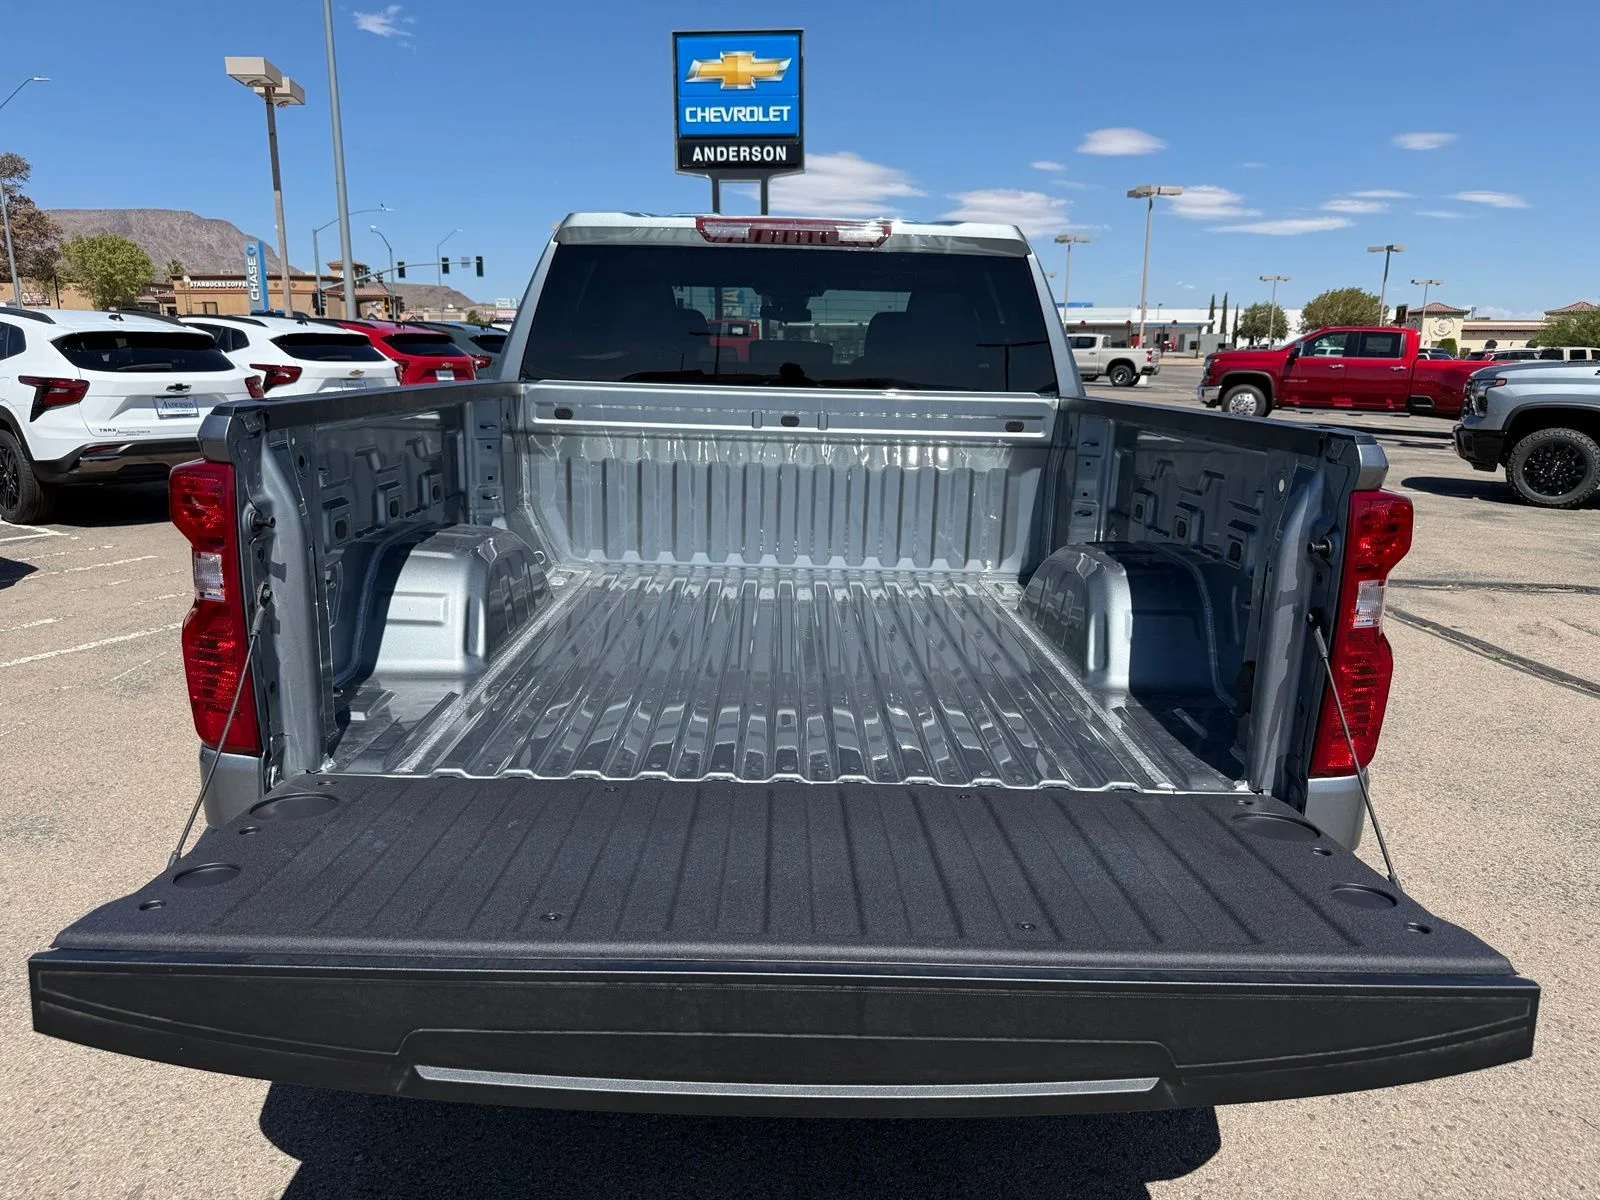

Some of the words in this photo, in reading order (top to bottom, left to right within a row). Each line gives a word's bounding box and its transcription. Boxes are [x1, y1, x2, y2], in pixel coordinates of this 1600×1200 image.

[685, 105, 792, 123] CHEVROLET
[692, 146, 787, 162] ANDERSON
[247, 257, 260, 301] CHASE
